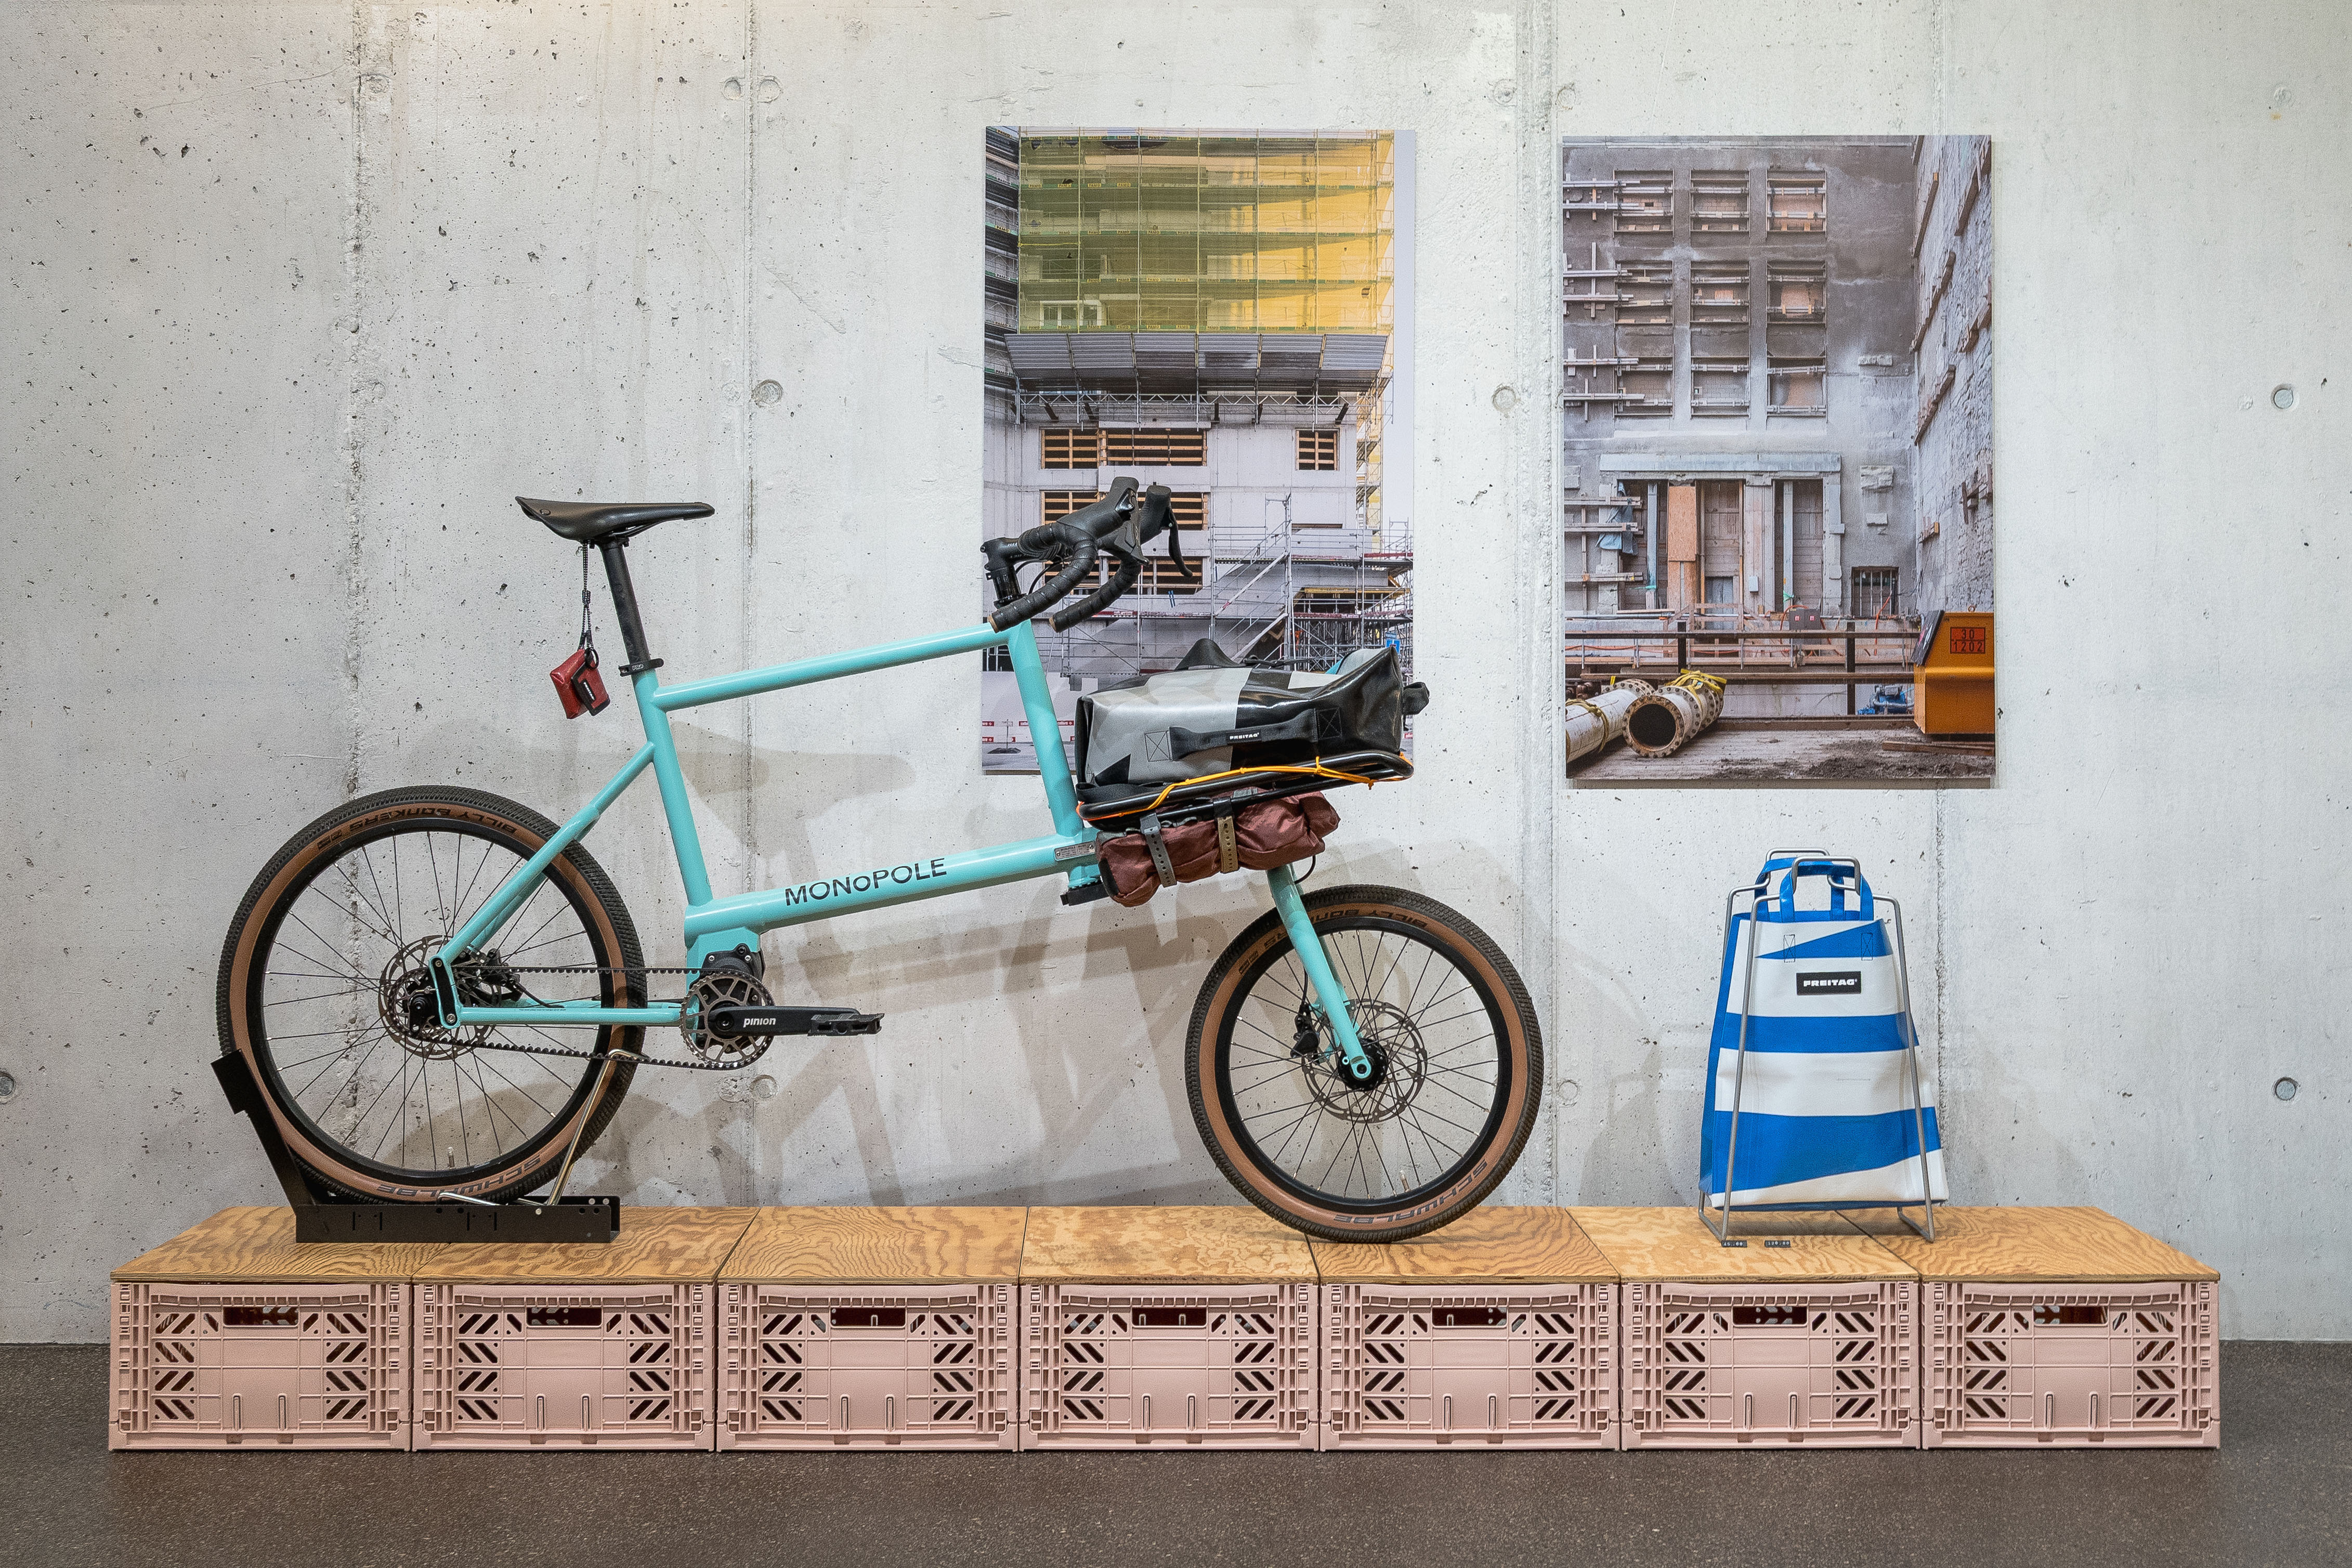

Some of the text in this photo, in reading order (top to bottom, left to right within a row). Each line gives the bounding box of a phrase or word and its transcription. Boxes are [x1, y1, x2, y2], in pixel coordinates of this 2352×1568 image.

[1962, 628, 1975, 639] 30
[1955, 641, 1982, 652] 1202
[349, 808, 517, 834] BILLY BONKERS
[1369, 910, 1428, 928] BILLY
[1804, 978, 1855, 987] FREITAG
[743, 1018, 776, 1028] pinion
[1334, 1159, 1487, 1224] SCHWALBE
